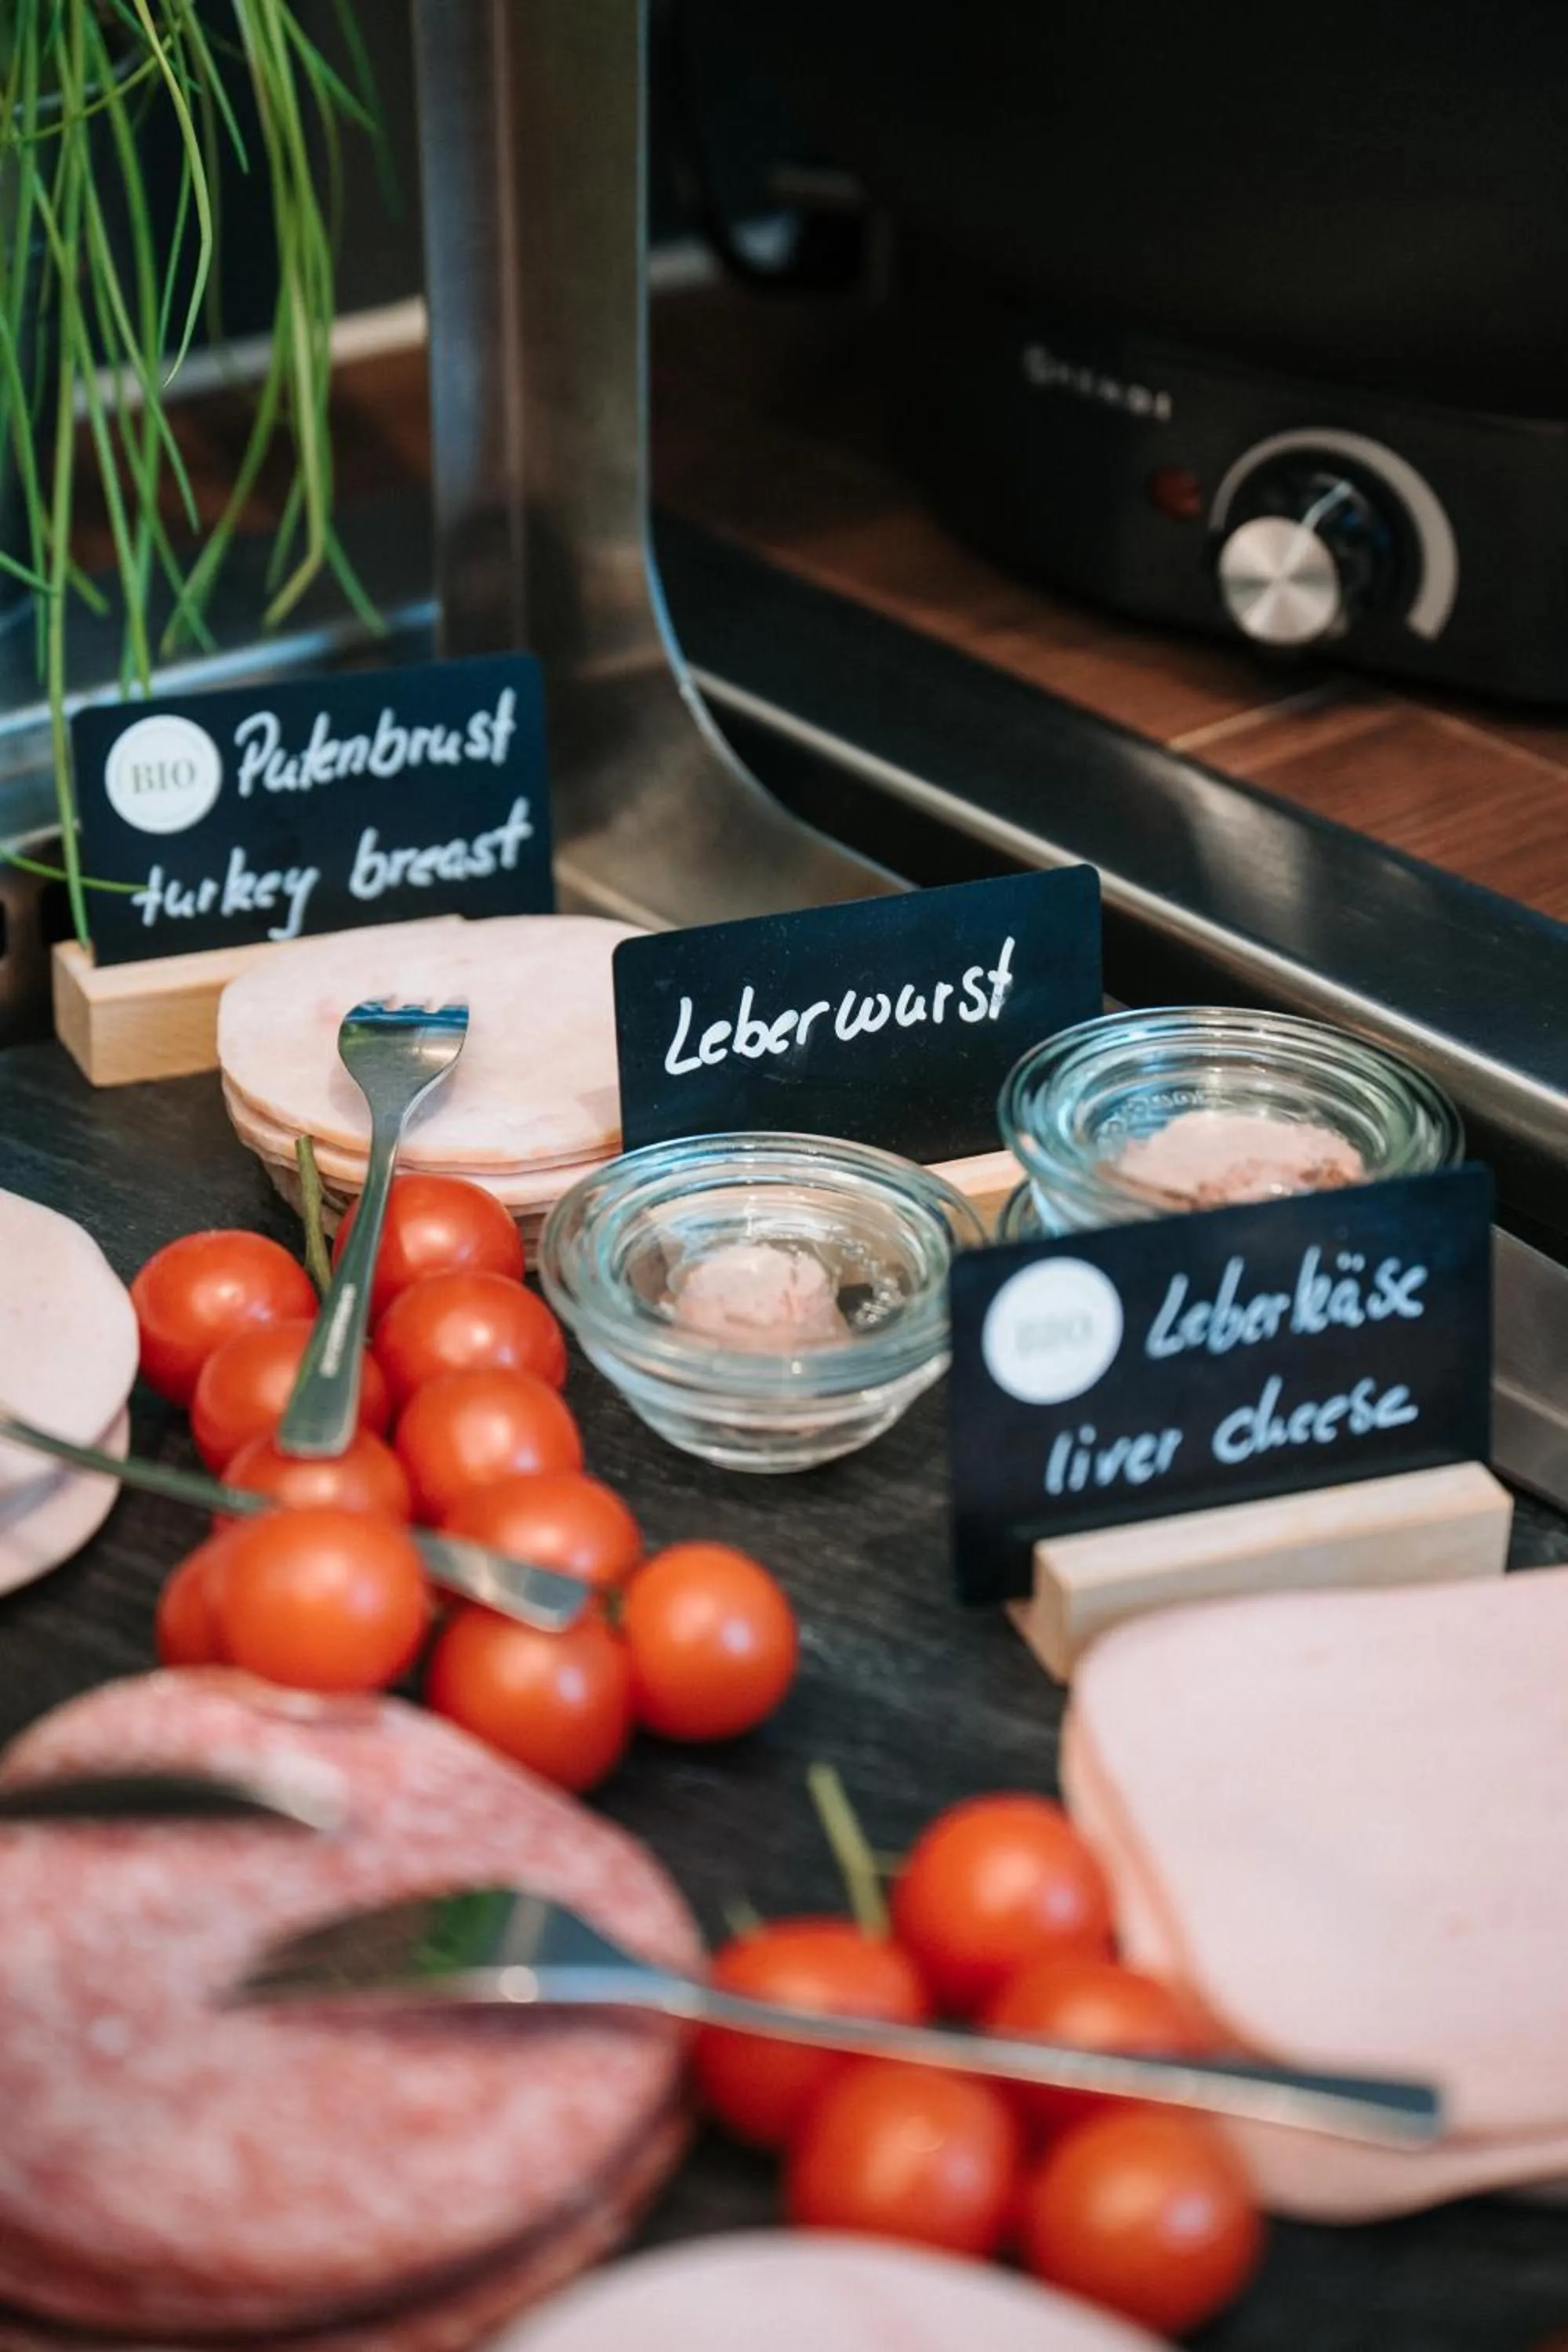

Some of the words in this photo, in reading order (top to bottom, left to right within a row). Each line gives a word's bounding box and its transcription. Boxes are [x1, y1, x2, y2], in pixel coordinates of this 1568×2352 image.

[131, 758, 198, 795] BIO
[234, 688, 516, 797] Putenbrust
[132, 847, 319, 941] turkey
[349, 797, 533, 900] breast
[665, 936, 1015, 1076] Leberwurst
[1147, 1246, 1426, 1357] Leberkäse
[1045, 1423, 1182, 1494] liver
[1211, 1376, 1418, 1463] cheese
